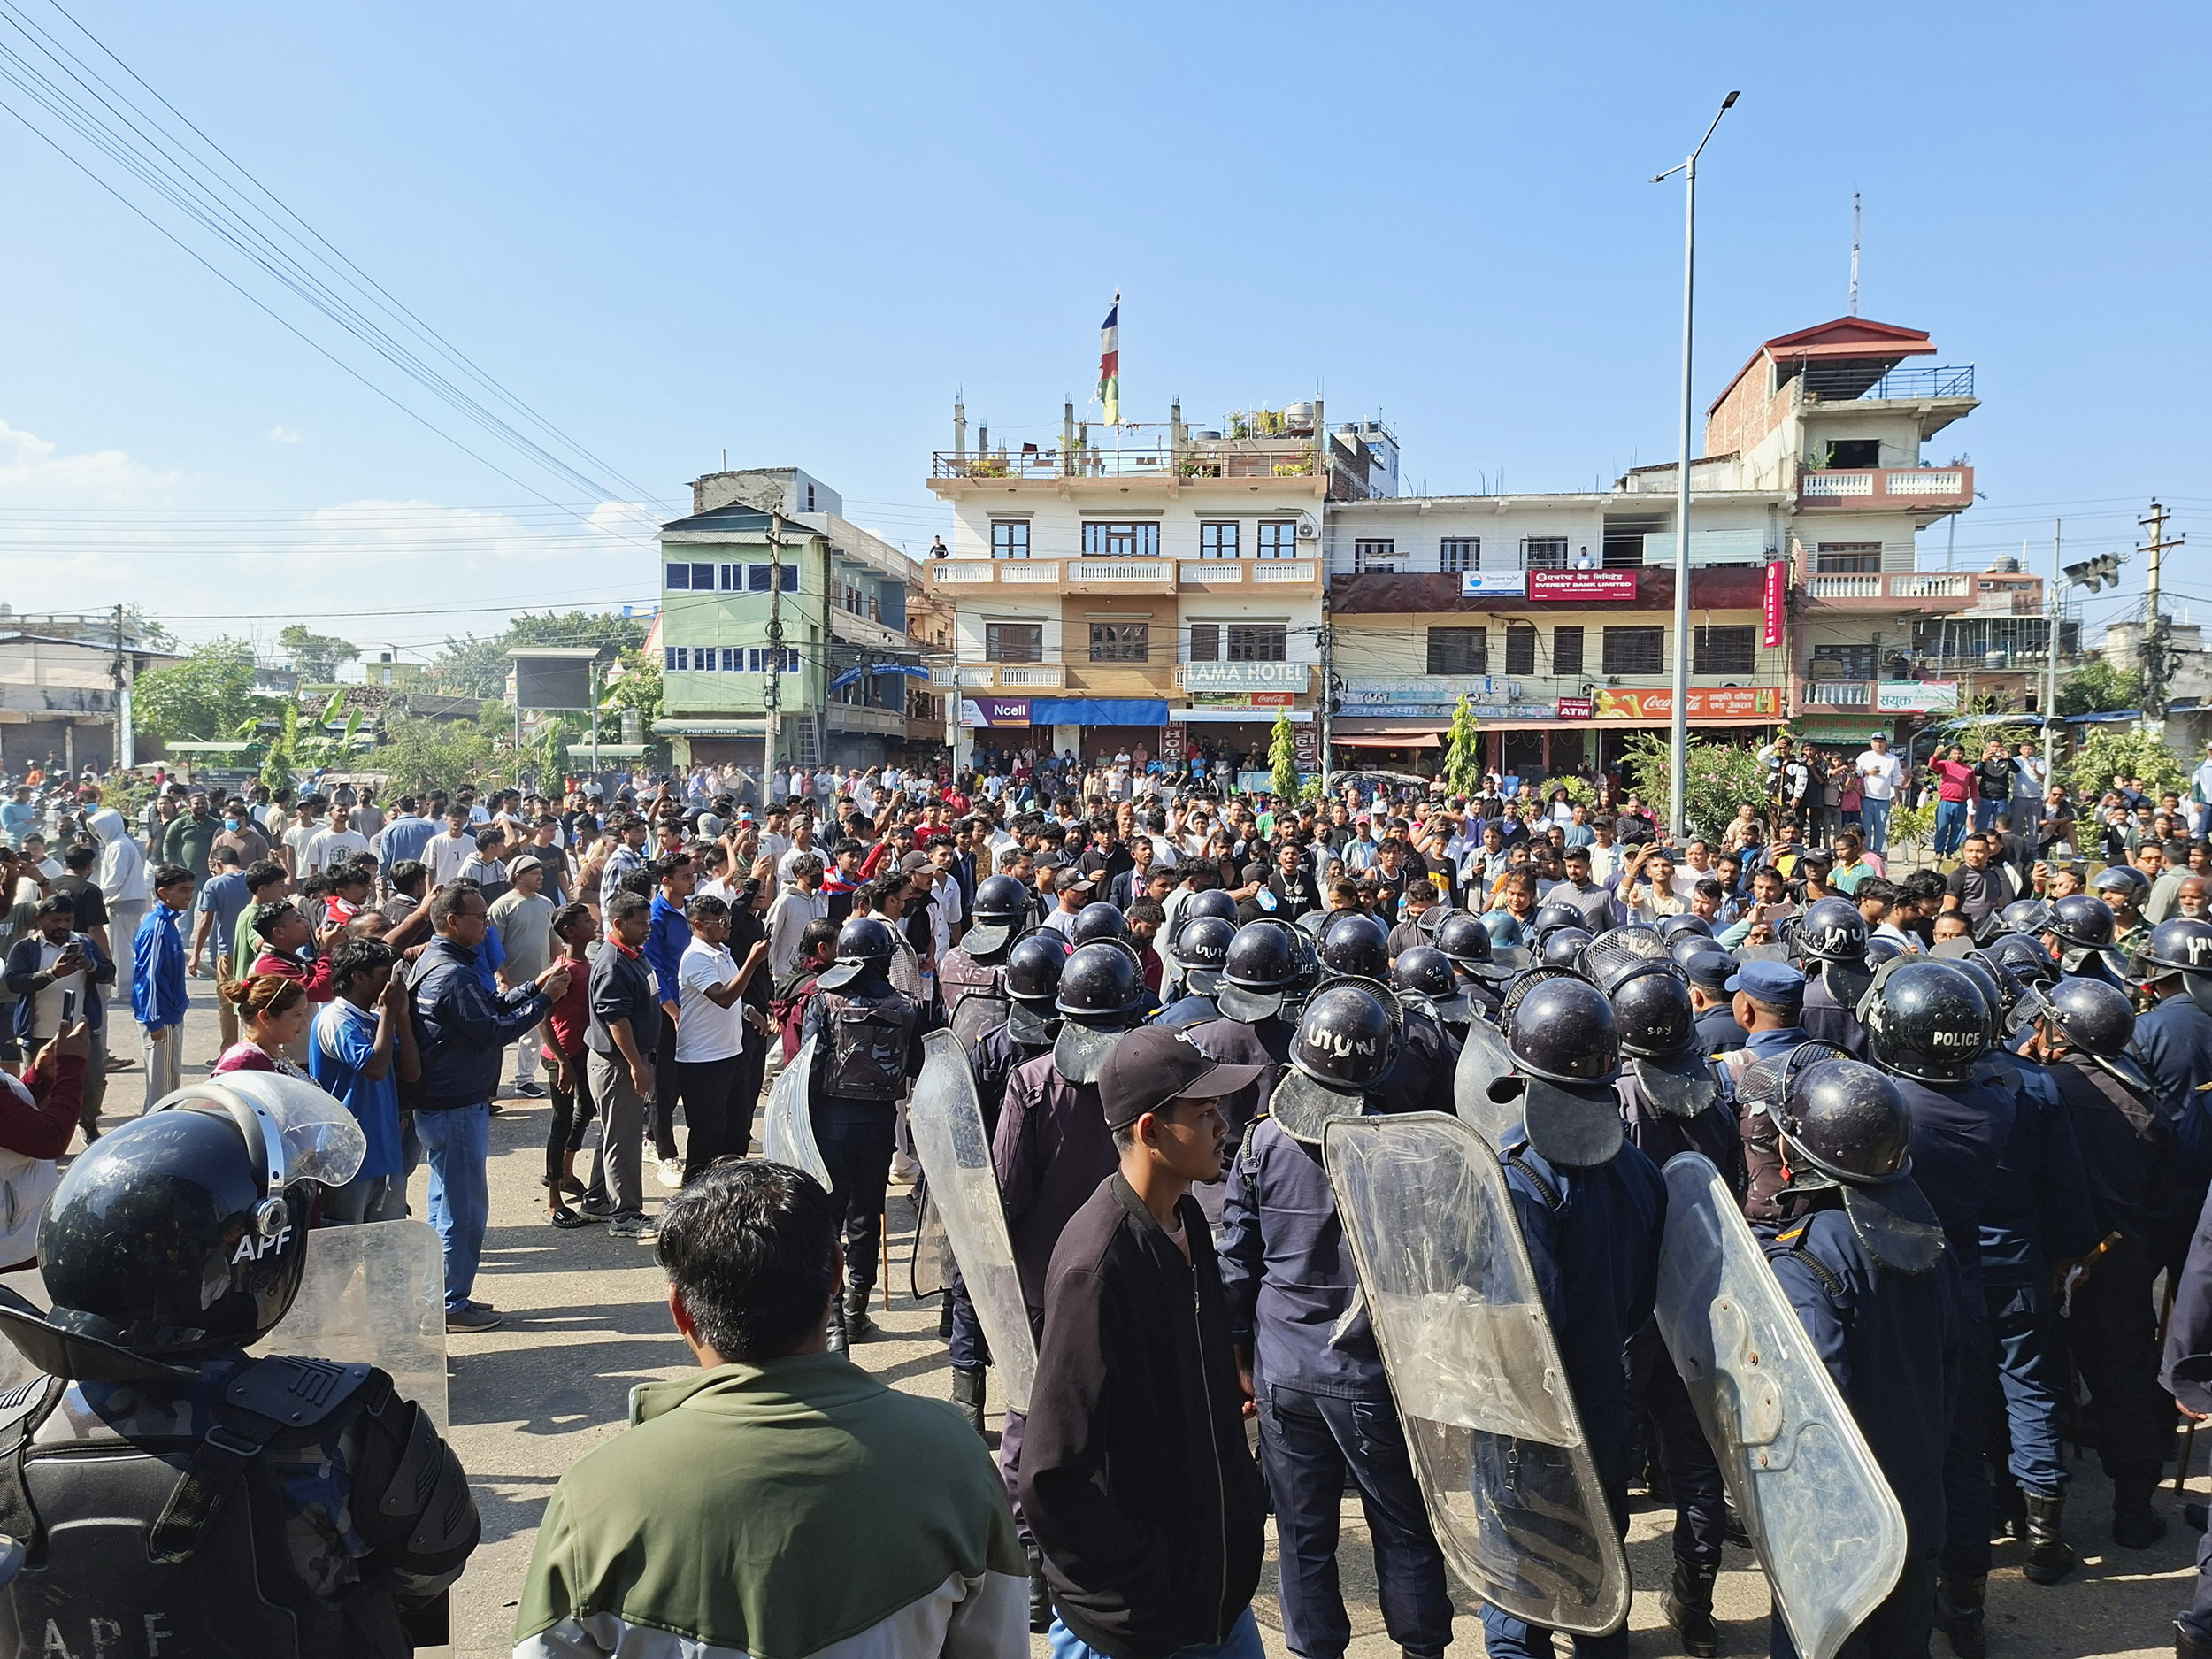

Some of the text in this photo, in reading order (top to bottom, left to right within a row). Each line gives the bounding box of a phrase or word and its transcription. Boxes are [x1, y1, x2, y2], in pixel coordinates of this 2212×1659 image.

[1188, 664, 1303, 680] LAMA HOTEL
[1257, 695, 1286, 703] Coca-Cola
[1879, 694, 1913, 708] संयुक्त
[994, 704, 1025, 716] Ncell
[1560, 707, 1589, 716] ATM
[1932, 1031, 1980, 1047] POLICE
[231, 1225, 293, 1265] APF
[44, 1612, 173, 1659] APF
